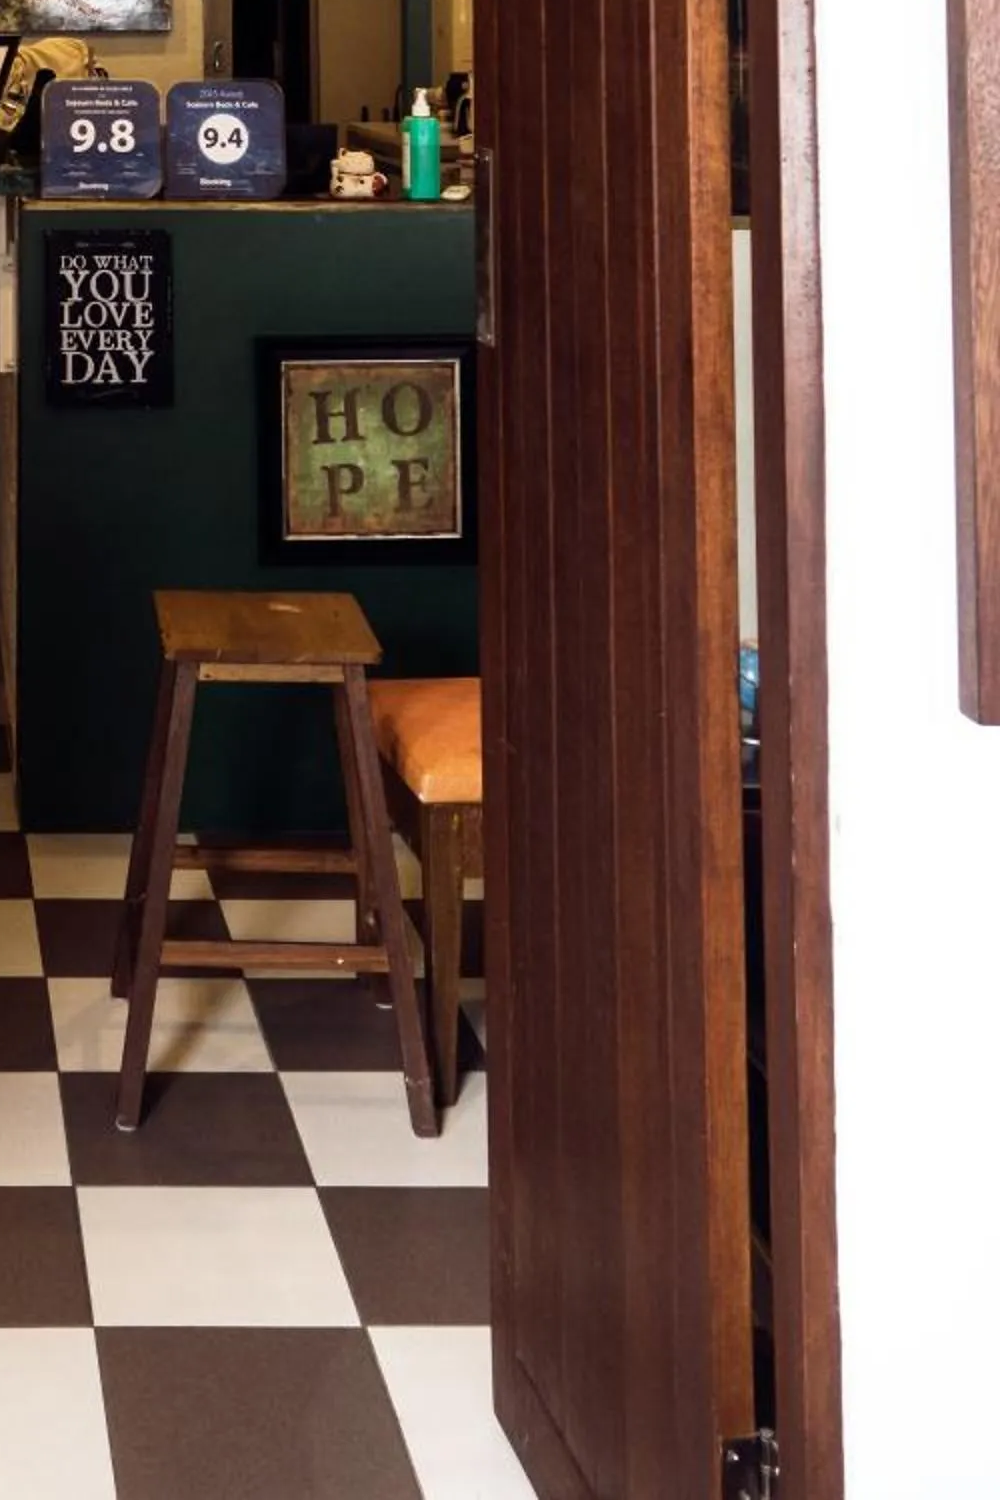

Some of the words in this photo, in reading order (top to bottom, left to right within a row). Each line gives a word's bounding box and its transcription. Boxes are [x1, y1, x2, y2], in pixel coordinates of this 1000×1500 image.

[69, 118, 136, 154] 9.8
[203, 127, 243, 149] 9.4
[61, 255, 87, 269] DO
[93, 255, 153, 270] WHAT
[60, 269, 153, 302] YOU
[60, 301, 155, 329] LOVE
[60, 329, 154, 351] EVERY
[60, 351, 155, 384] DAY
